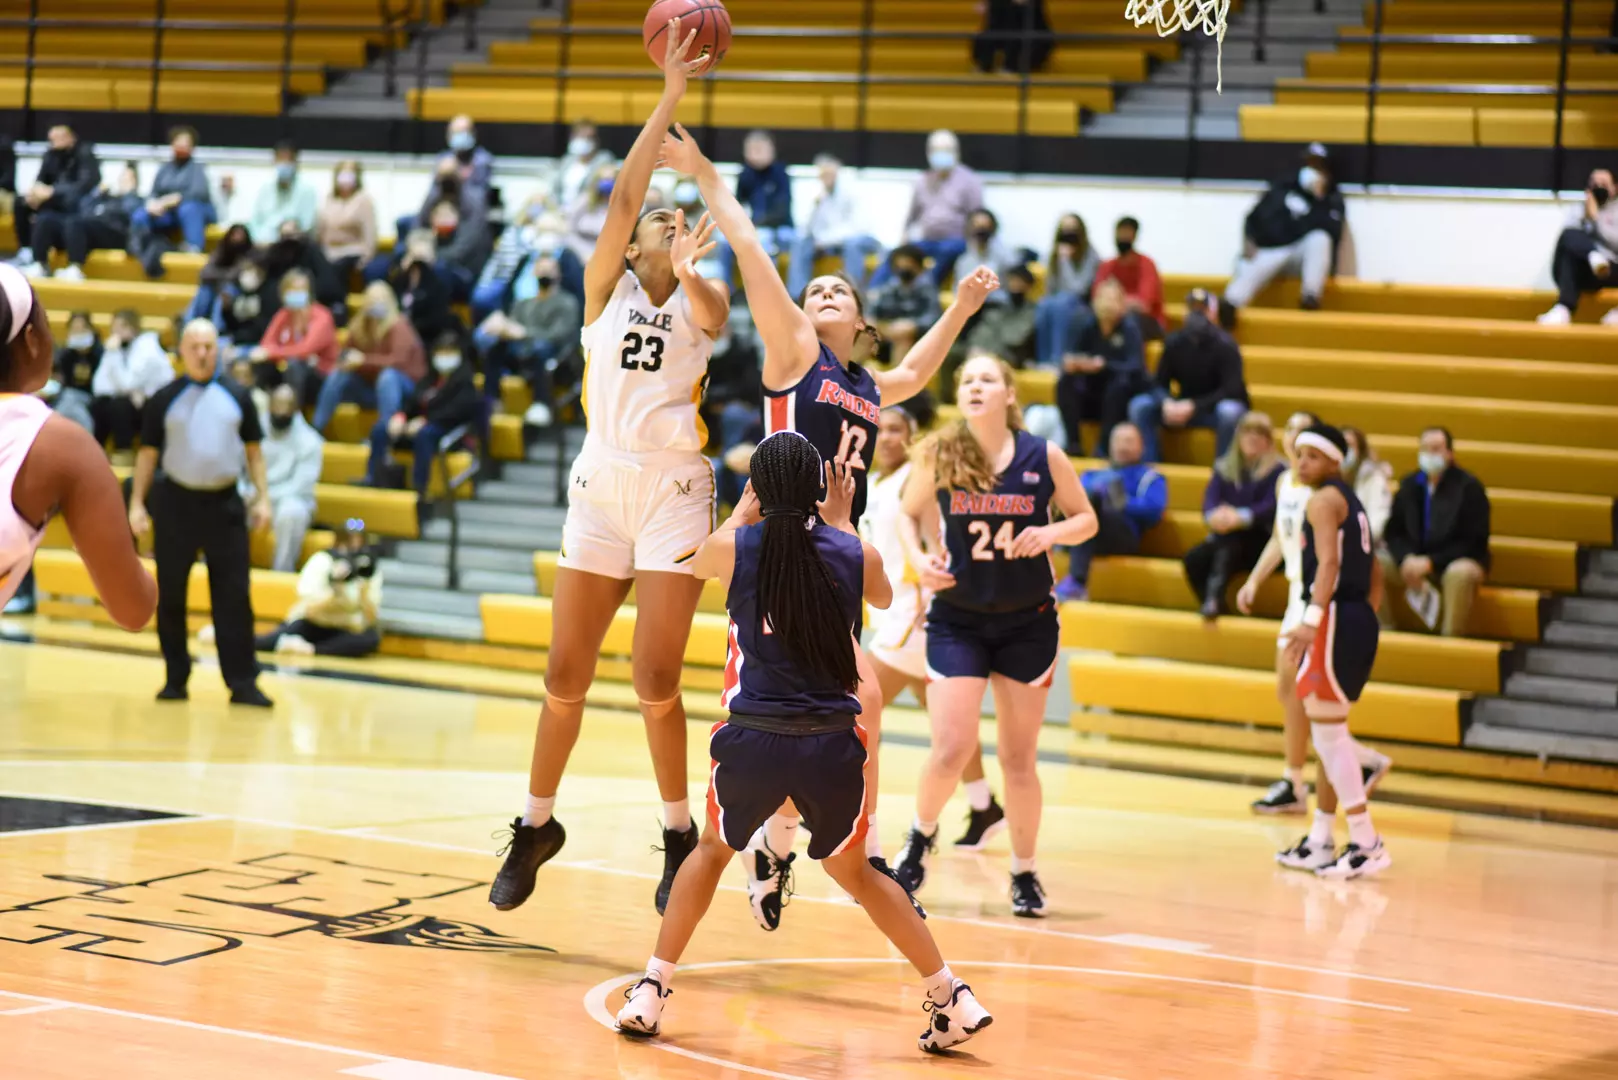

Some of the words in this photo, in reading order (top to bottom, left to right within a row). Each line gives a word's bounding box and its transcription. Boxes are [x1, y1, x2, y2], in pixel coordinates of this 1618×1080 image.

[621, 332, 664, 372] 23
[950, 490, 1035, 516] RAIDERS
[967, 520, 1015, 560] 24
